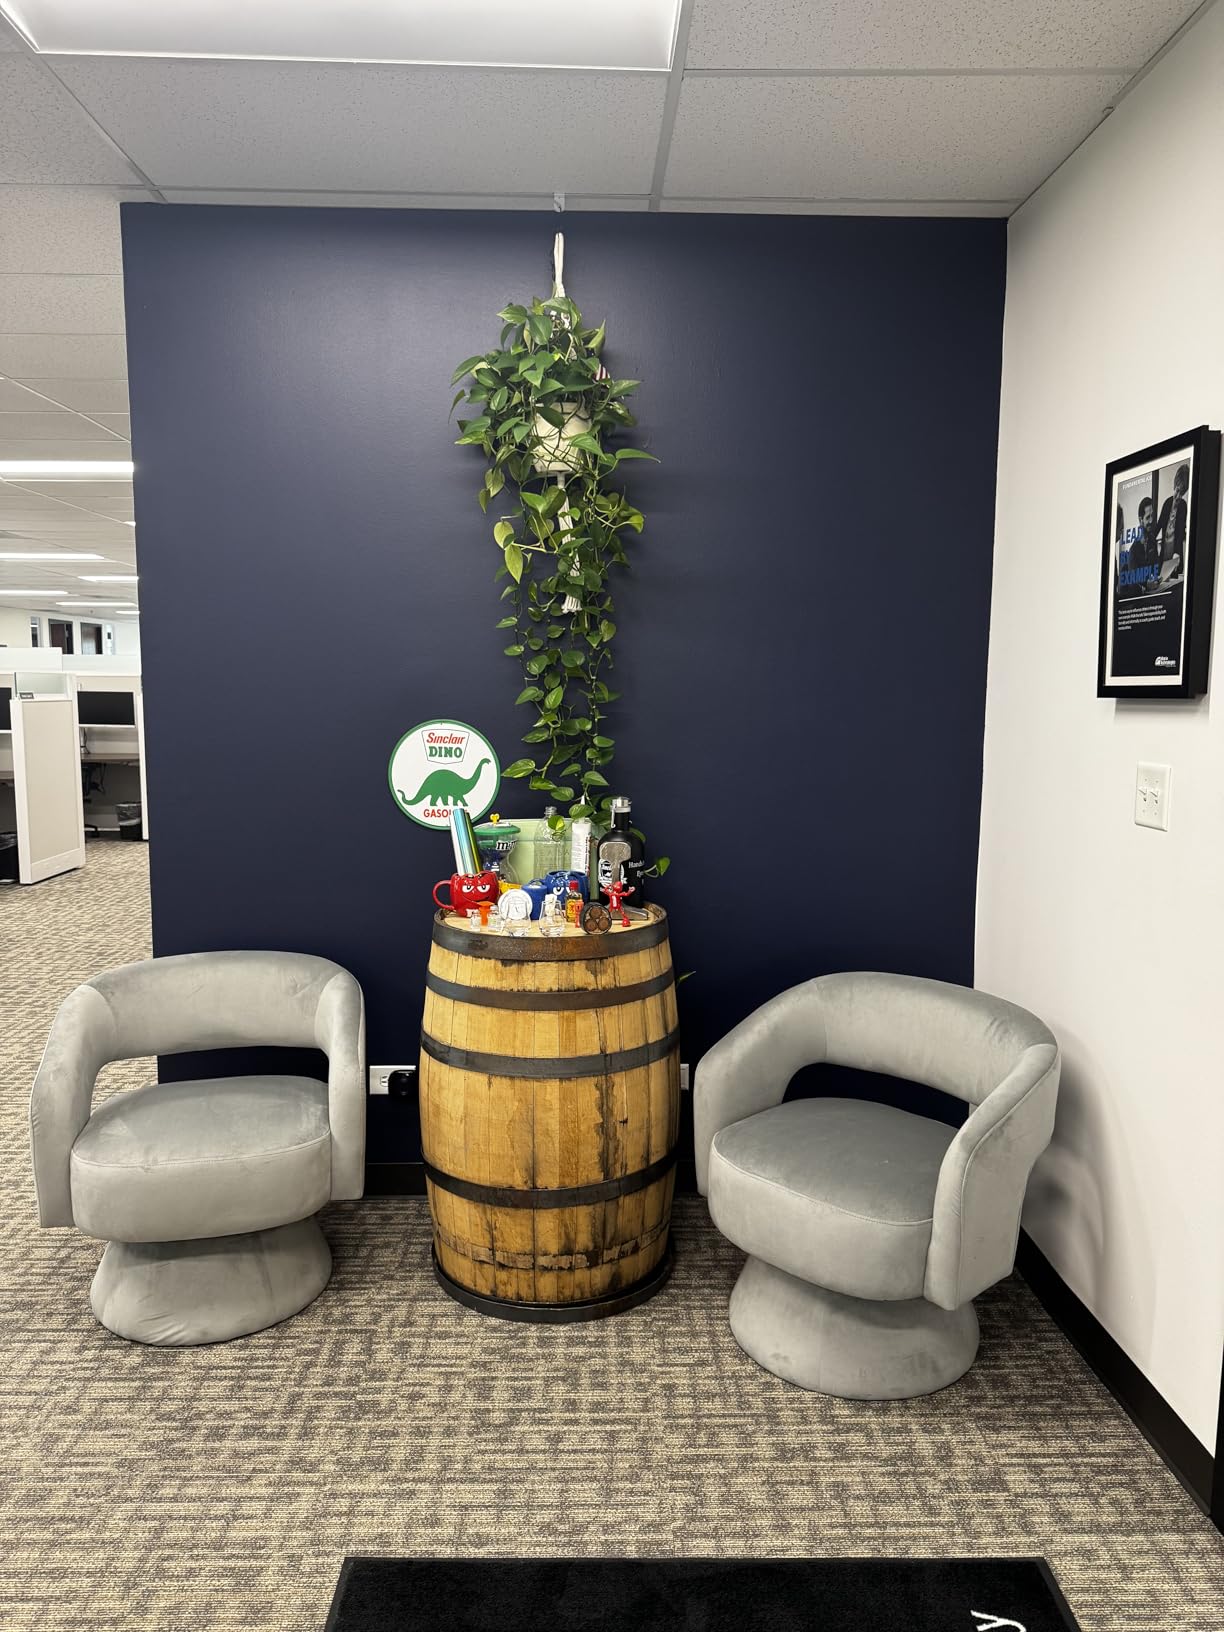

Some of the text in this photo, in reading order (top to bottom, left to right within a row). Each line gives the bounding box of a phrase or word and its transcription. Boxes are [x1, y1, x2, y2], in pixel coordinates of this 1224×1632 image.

[1119, 527, 1144, 544] LEAD
[1119, 551, 1131, 565] BY
[1119, 563, 1159, 585] EXAMPLE
[426, 732, 465, 745] Sinclair
[428, 745, 463, 758] DINO
[423, 808, 468, 818] GASO
